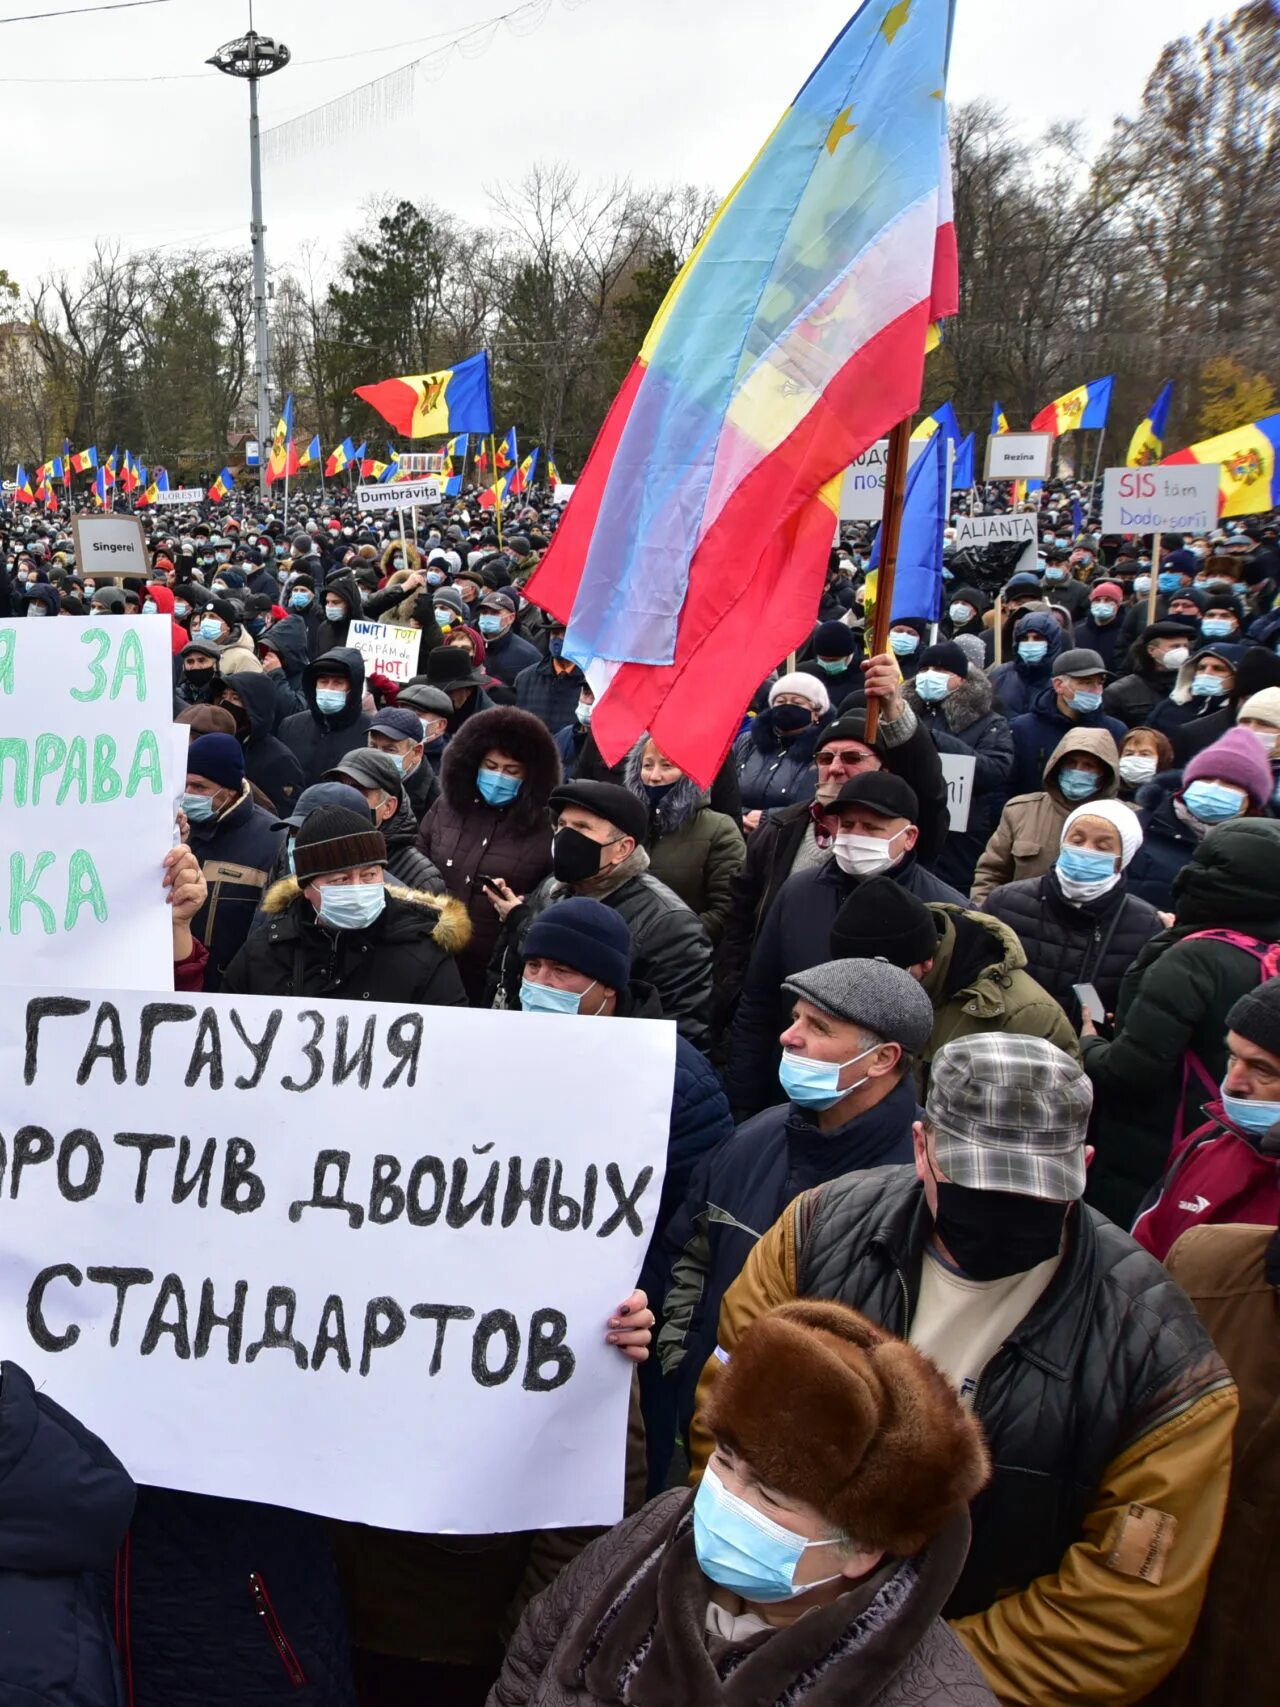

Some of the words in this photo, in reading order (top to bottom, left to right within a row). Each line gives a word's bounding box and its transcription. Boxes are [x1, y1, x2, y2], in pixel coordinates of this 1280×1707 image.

[361, 486, 437, 503] Dumbrăvița
[70, 627, 147, 702] ЗА
[23, 996, 423, 1091] ГАГАУЗИЯ
[288, 1141, 653, 1238] ДВОЙНЫХ
[26, 1263, 576, 1392] СТАНДАРТОВ
